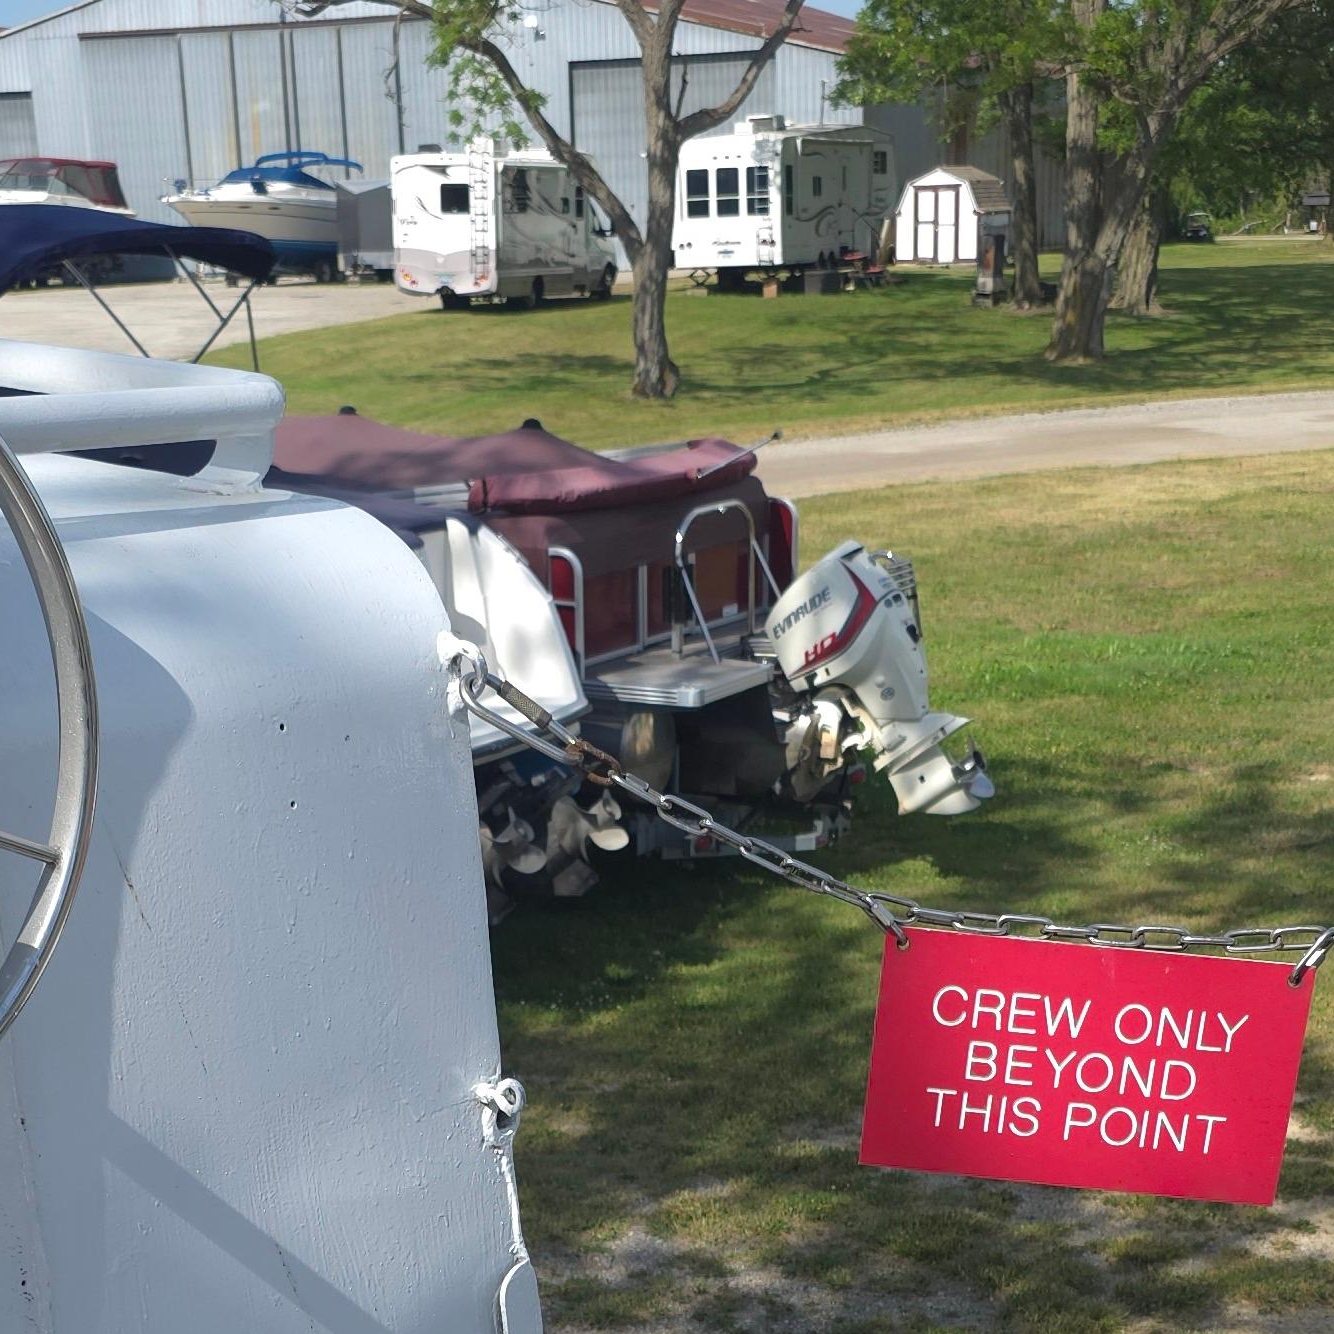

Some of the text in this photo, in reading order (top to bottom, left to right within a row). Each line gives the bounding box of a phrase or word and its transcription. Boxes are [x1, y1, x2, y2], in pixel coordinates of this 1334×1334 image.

[773, 588, 831, 640] EVINRUDE
[932, 985, 1249, 1053] CREW ONLY
[965, 1041, 1196, 1100] BEYOND
[926, 1087, 1227, 1154] THIS POINT
